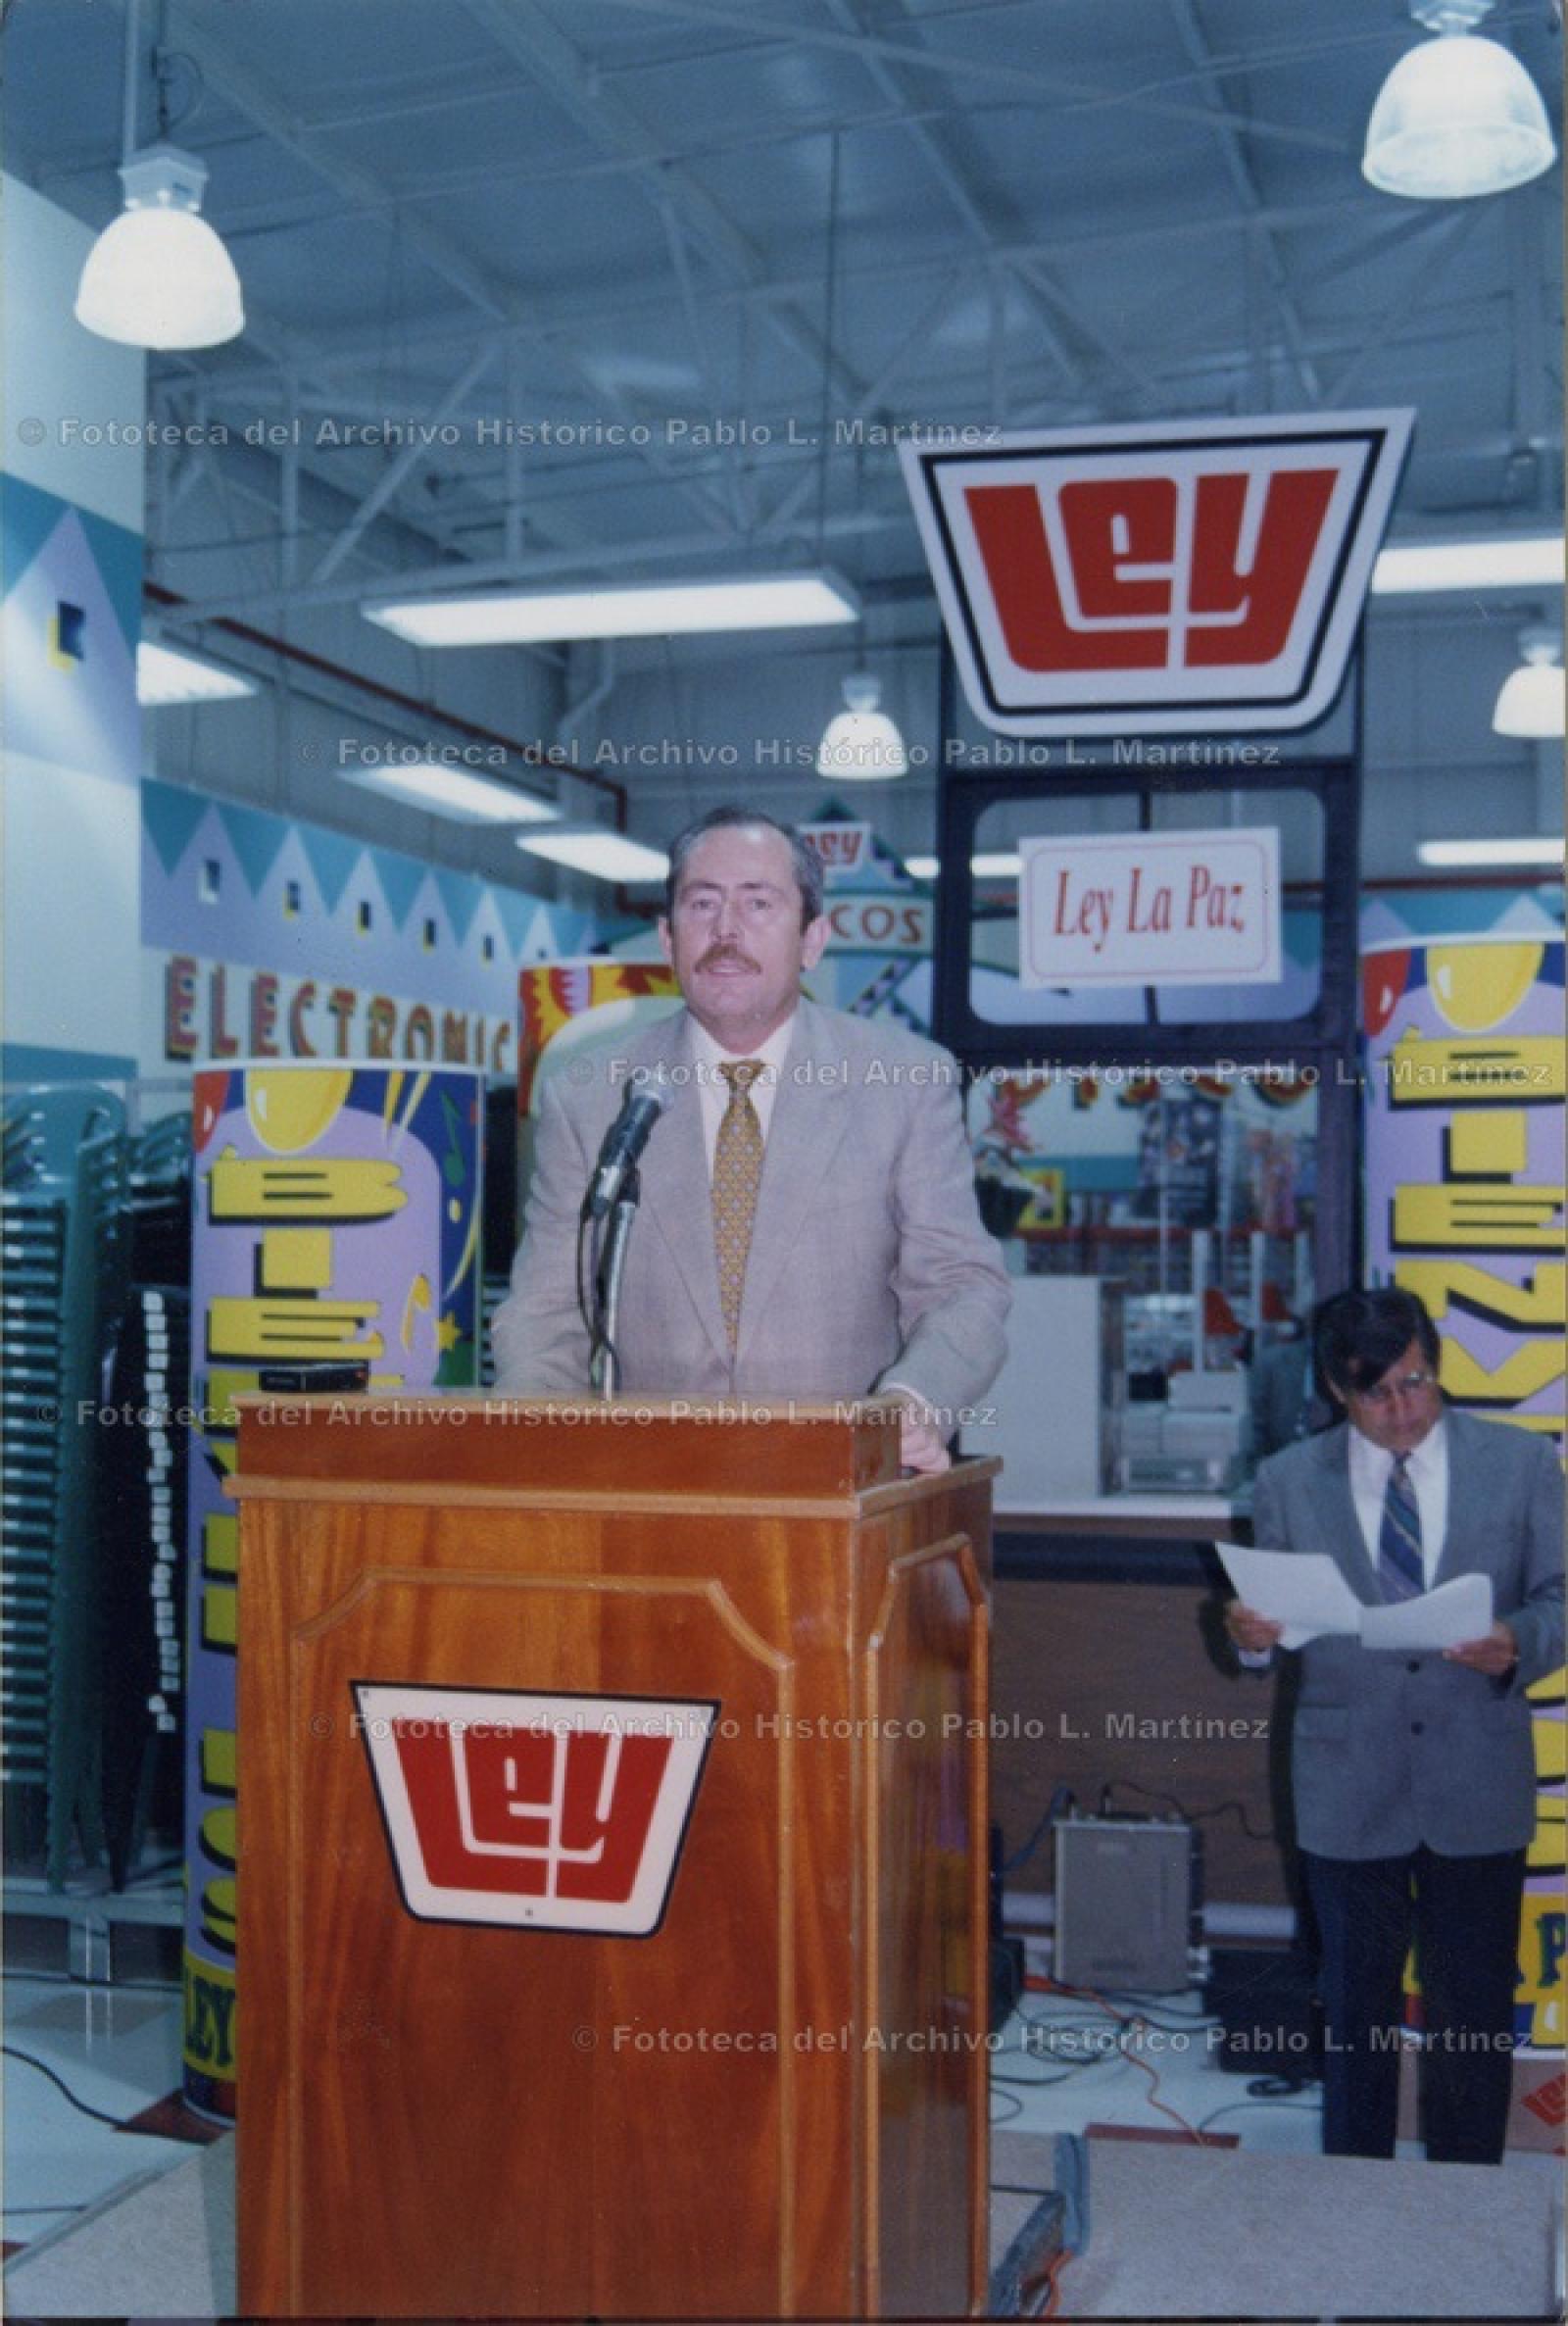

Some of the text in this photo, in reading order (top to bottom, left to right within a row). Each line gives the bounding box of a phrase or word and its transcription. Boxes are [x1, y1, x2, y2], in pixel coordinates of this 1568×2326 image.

[830, 903, 923, 945] COS
[1054, 864, 1245, 954] Ley La Paz
[165, 954, 512, 1073] ELECTRONIC
